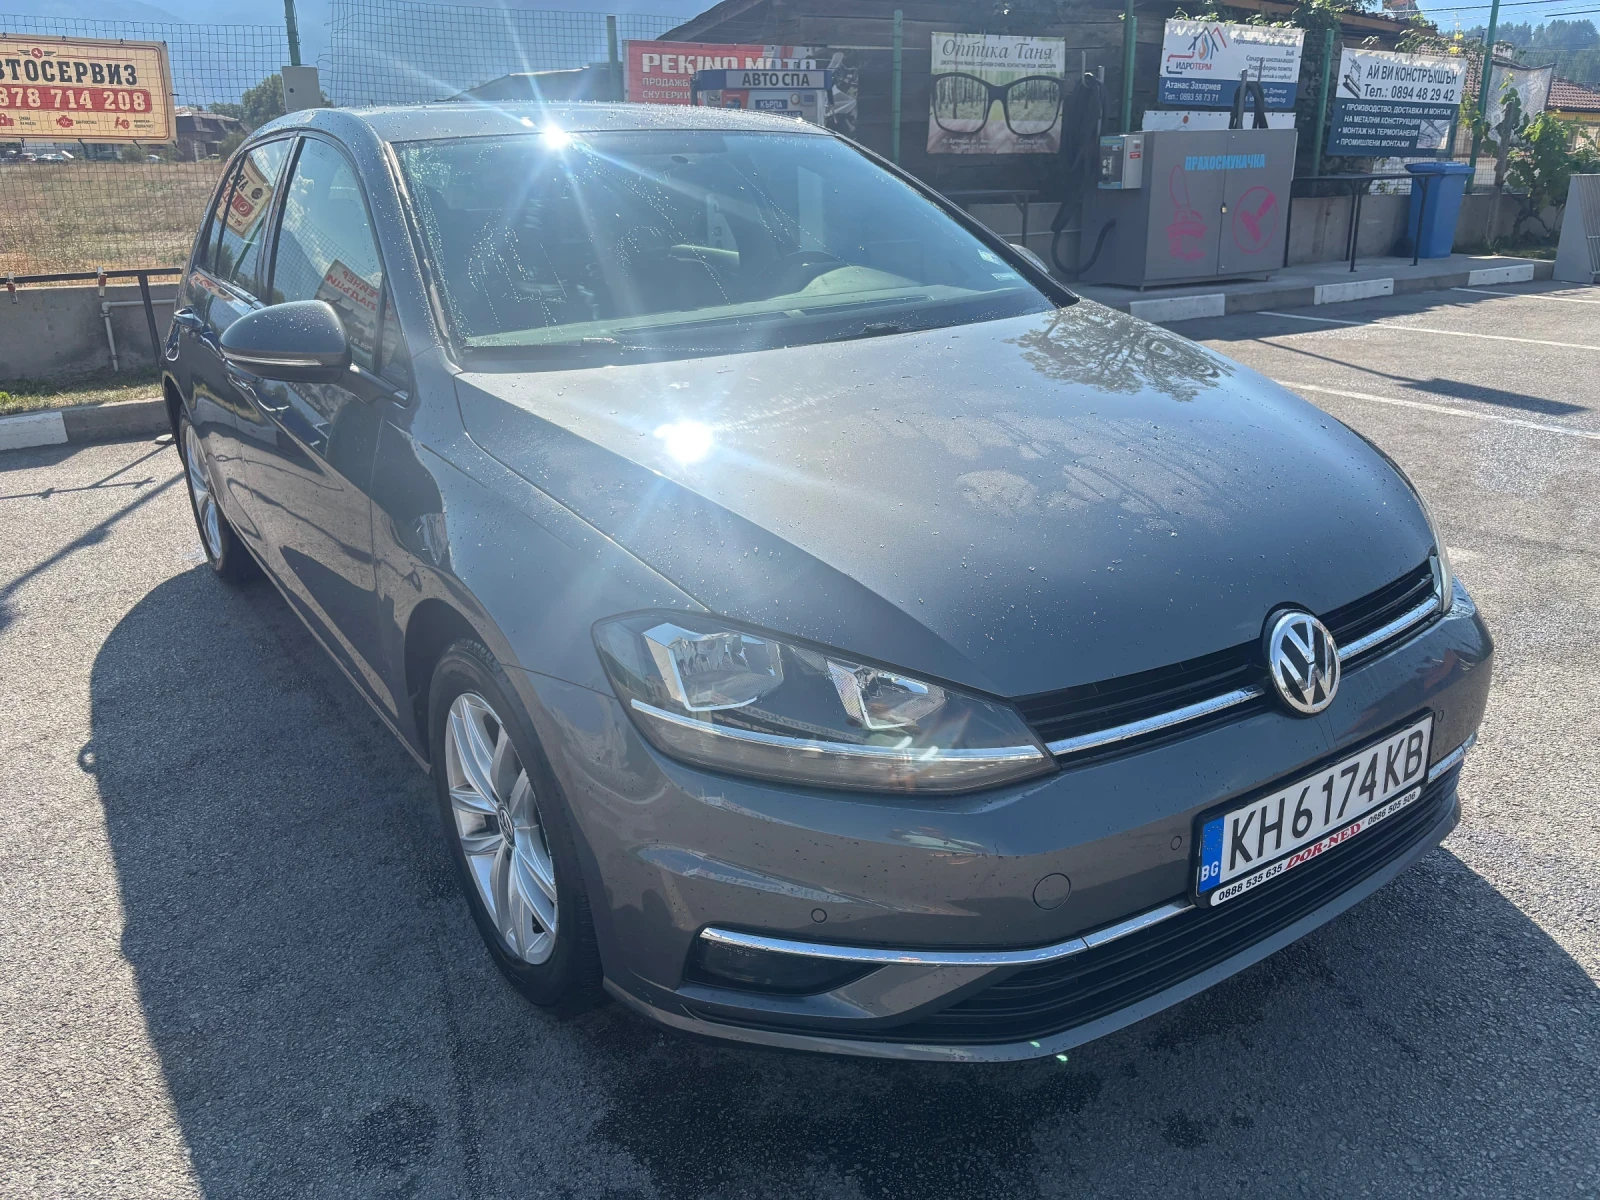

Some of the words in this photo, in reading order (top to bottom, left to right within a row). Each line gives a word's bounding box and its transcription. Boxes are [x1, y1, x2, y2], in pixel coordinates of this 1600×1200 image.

[942, 40, 1008, 59] Оптика
[1014, 43, 1052, 60] Таня
[742, 73, 779, 86] АВТО
[782, 73, 810, 86] СПА
[1367, 62, 1379, 80] АЙ
[1382, 66, 1394, 80] ВИ
[1395, 68, 1457, 85] КОНСТРЪКШЪН
[642, 78, 691, 87] ПРОДАЖБ
[1165, 80, 1189, 89] Атанас
[1190, 81, 1221, 91] Захариев
[51, 89, 92, 109] 714
[103, 91, 145, 110] 208
[1364, 84, 1388, 98] Тел.:
[1391, 86, 1413, 100] 0894
[1416, 88, 1427, 100] 48
[1430, 89, 1441, 101] 29
[1443, 89, 1455, 101] 42
[760, 101, 783, 110] КЪРПА
[1346, 104, 1392, 113] ПРОИЗВОДСТВО,
[1377, 128, 1418, 136] ТЕРМОПАНЕЛИ
[1185, 154, 1265, 170] ПРАХОСМУКАЧКА
[1218, 882, 1243, 901] 0888
[1246, 873, 1263, 889] 535
[1265, 863, 1283, 880] 635
[1285, 823, 1361, 870] DOR-NED
[1201, 860, 1219, 882] BG
